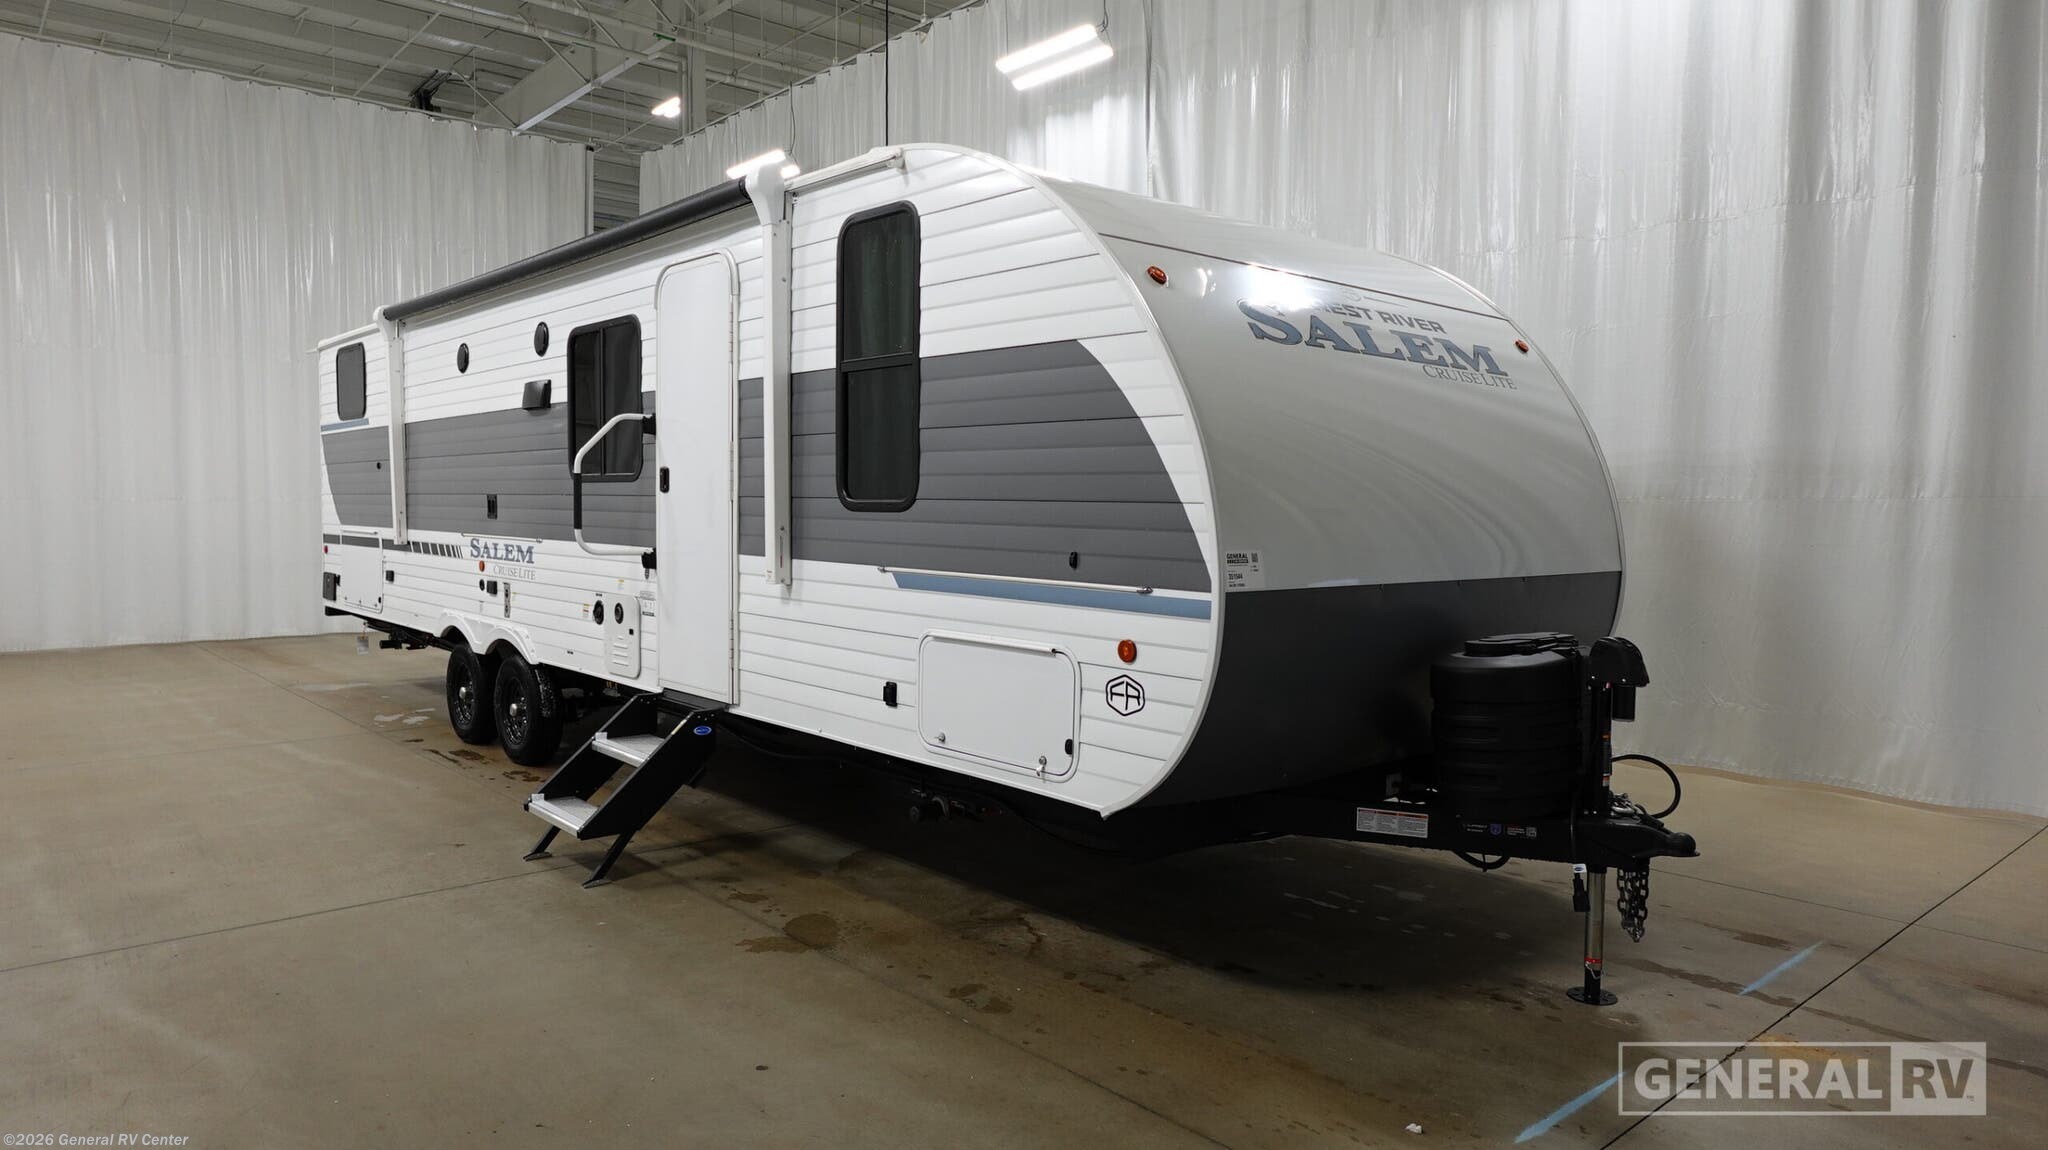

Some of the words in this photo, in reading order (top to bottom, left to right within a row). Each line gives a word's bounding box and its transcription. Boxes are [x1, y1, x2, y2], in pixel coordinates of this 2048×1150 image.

[1375, 310, 1447, 334] RIVER
[1237, 297, 1509, 377] SALEM
[1422, 364, 1518, 390] CRUISELITE
[470, 537, 535, 564] SALEM
